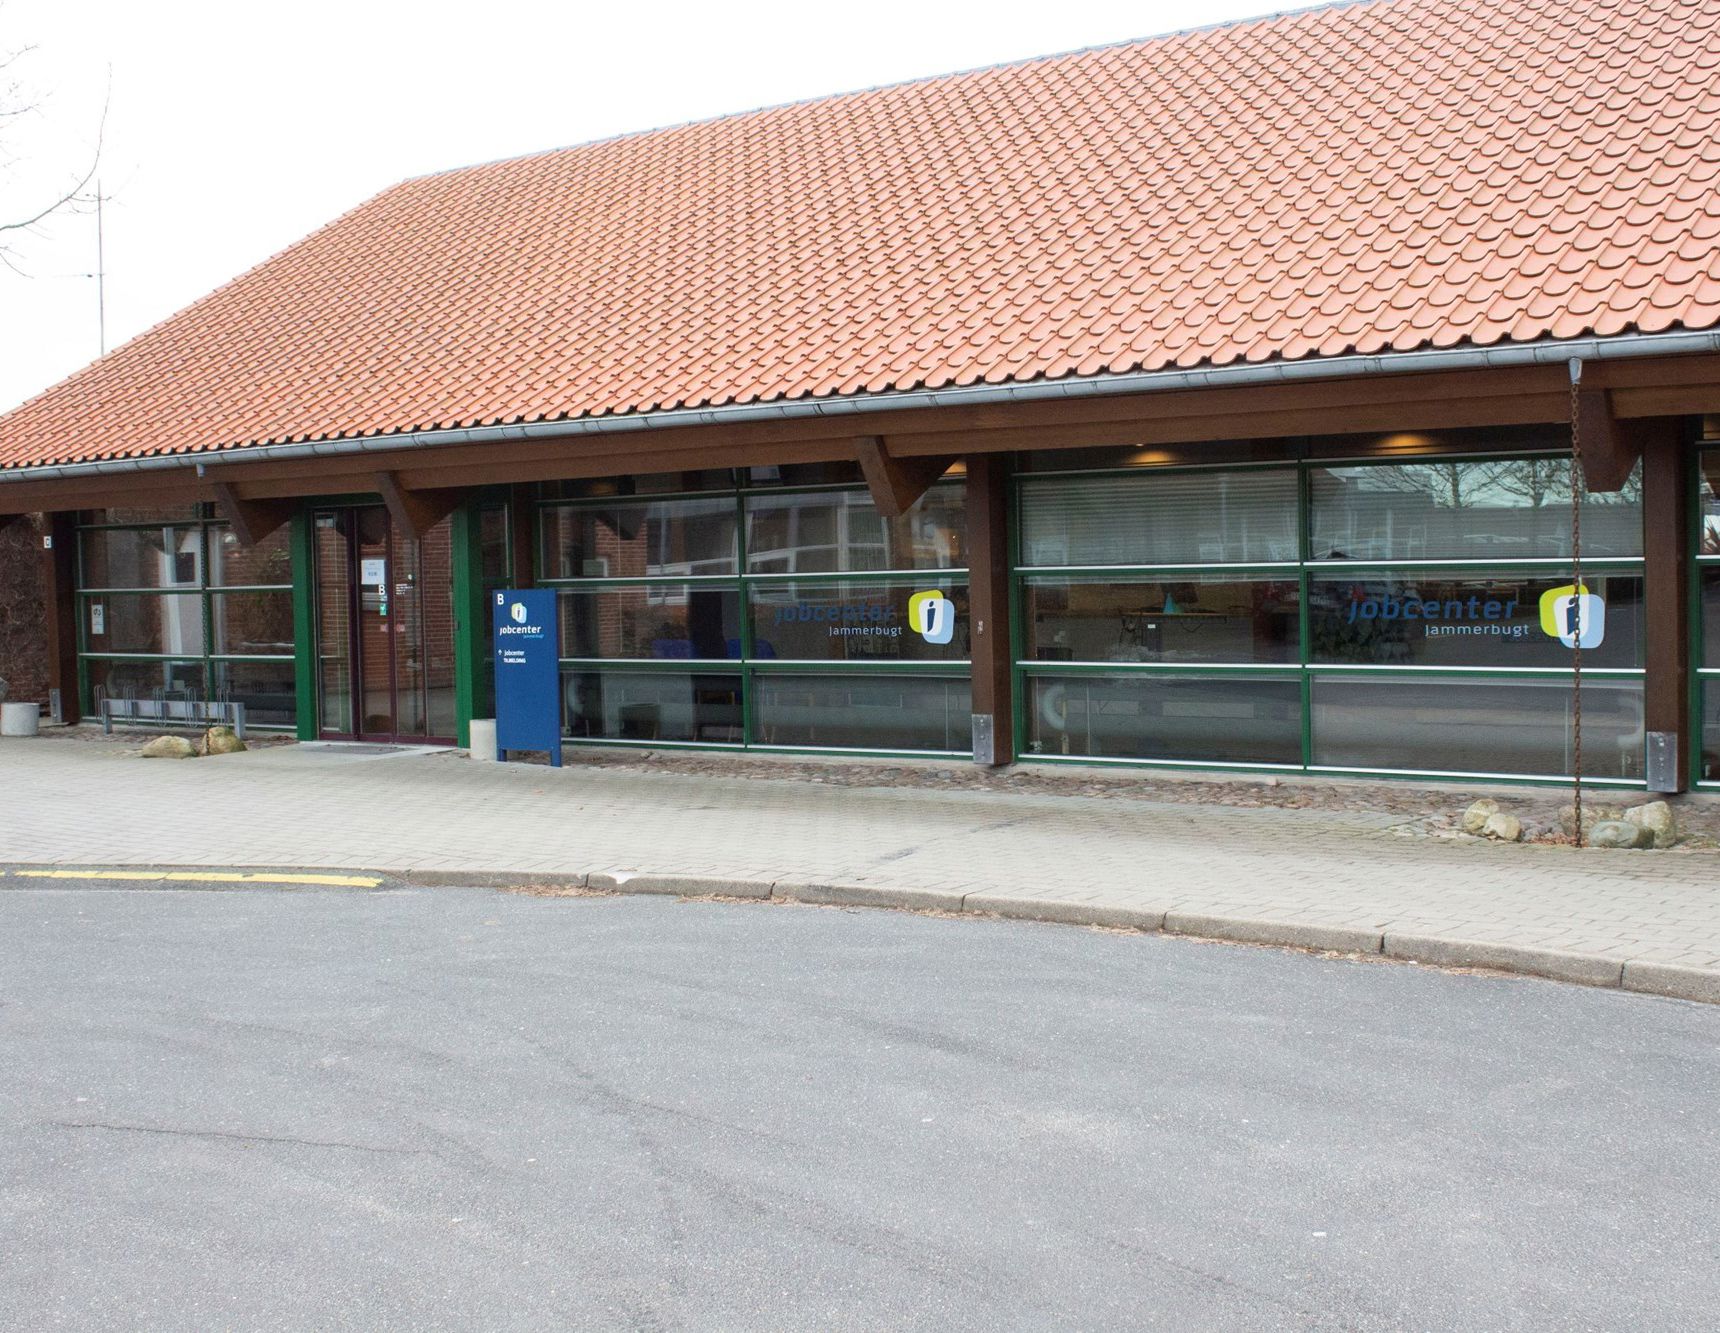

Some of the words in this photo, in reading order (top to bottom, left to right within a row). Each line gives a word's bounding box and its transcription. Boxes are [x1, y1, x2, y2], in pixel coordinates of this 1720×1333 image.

[379, 584, 386, 595] B
[497, 593, 504, 605] B
[774, 602, 897, 625] jobcenter
[1347, 594, 1519, 625] jobcenter
[499, 625, 542, 636] jobcenter
[829, 626, 903, 637] Jammerbugt
[1425, 624, 1530, 637] Jammerbugt
